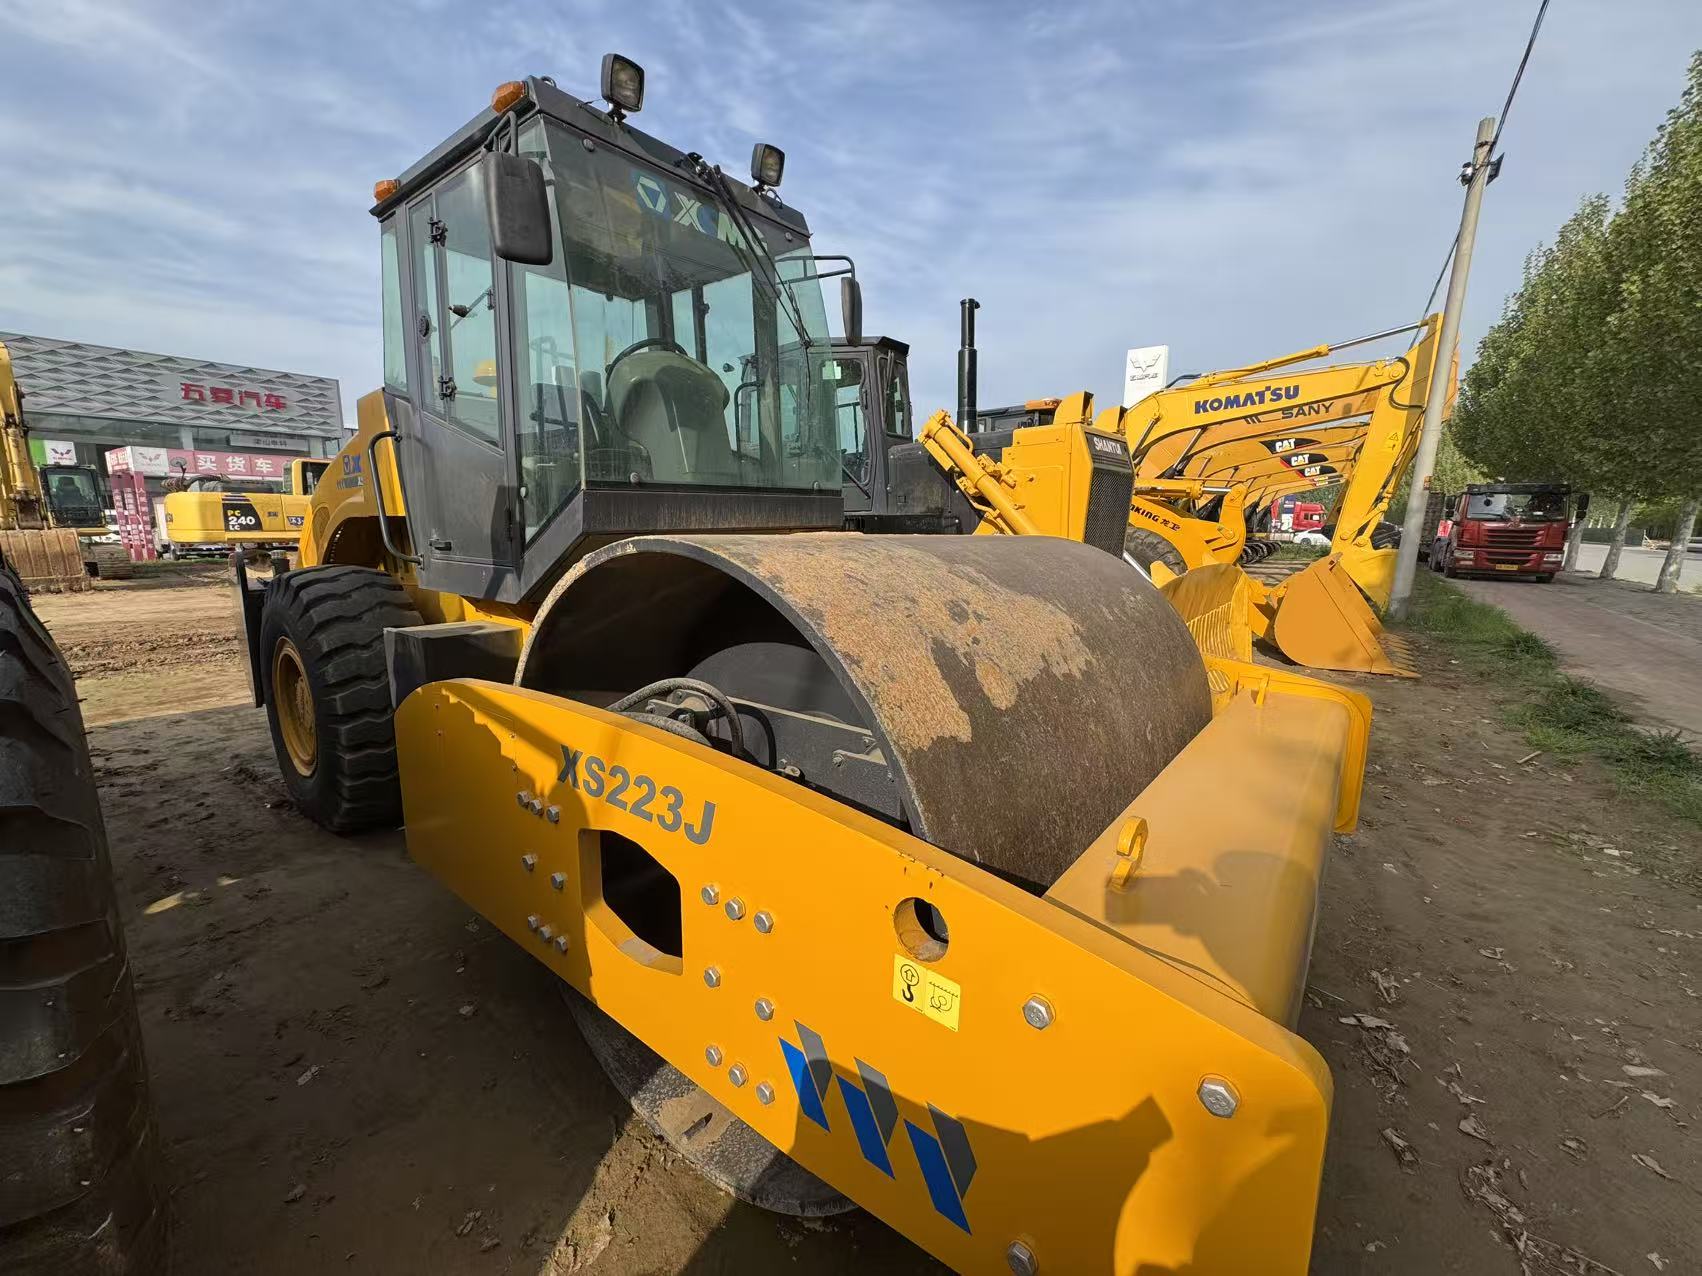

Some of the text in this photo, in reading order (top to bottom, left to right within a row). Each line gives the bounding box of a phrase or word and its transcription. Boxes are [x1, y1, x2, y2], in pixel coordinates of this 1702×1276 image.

[1194, 385, 1300, 414] KOMATSU
[1281, 402, 1335, 419] SANY
[1275, 438, 1296, 453] CAT
[196, 454, 274, 473] 买货车
[1290, 453, 1310, 466] CAT
[1304, 465, 1321, 477] CAT
[228, 516, 256, 525] 240
[557, 744, 716, 846] XS223J
